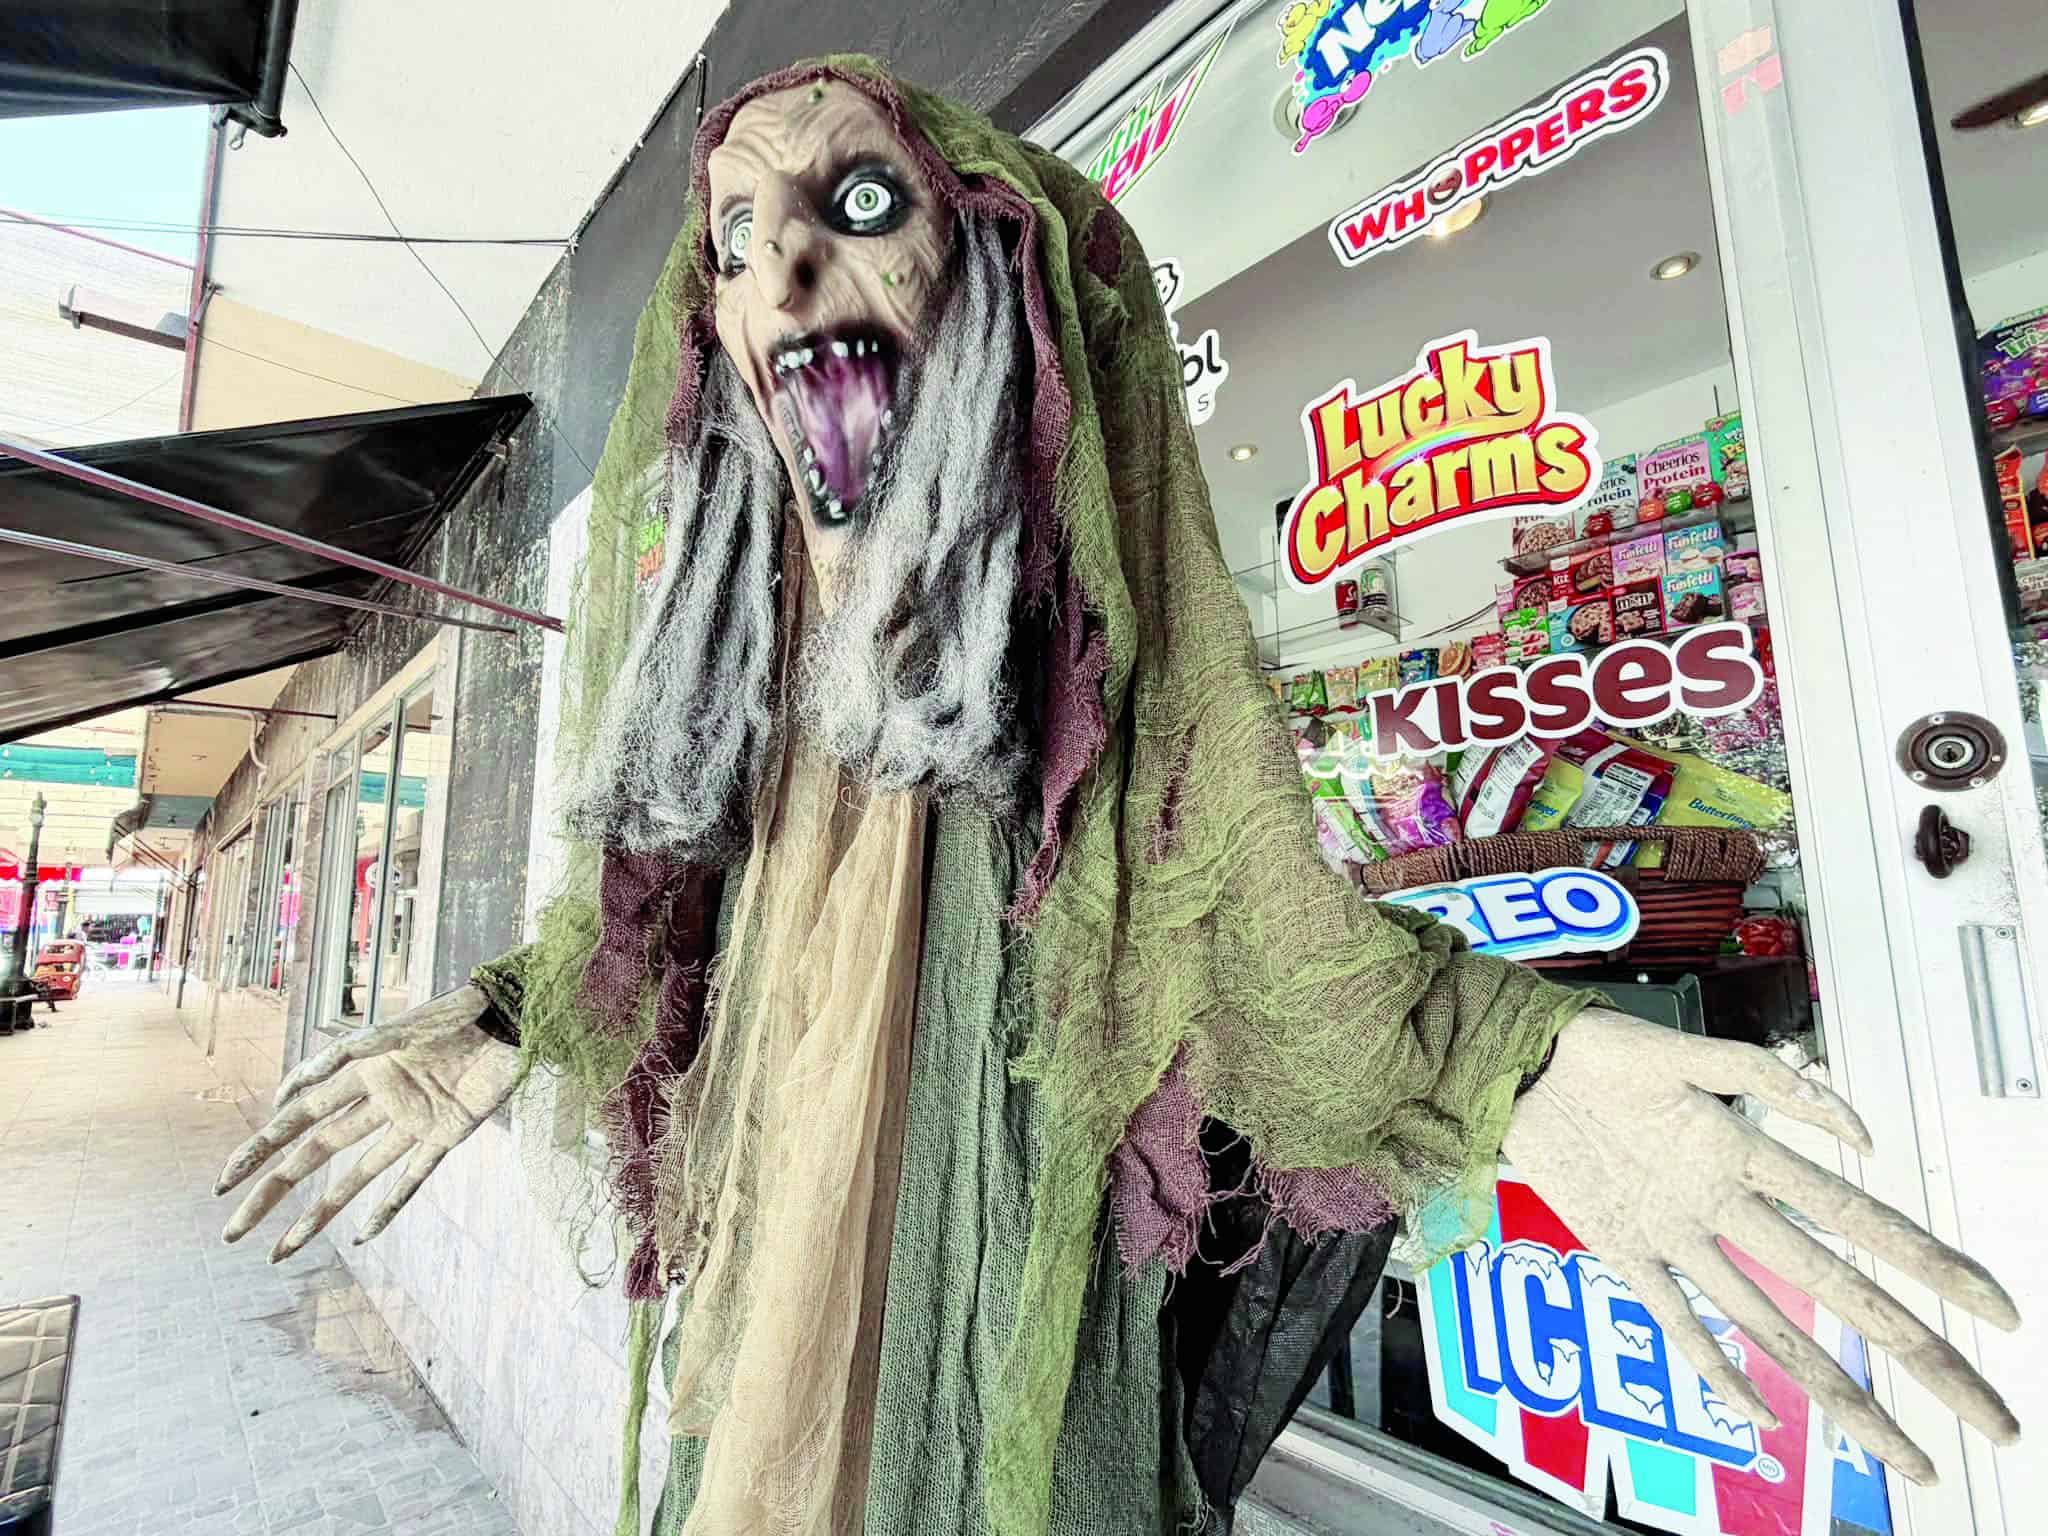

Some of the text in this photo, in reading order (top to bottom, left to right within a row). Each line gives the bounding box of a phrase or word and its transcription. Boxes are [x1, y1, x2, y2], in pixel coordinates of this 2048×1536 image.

[1316, 0, 1432, 78] Ne
[1345, 66, 1648, 250] WHOPPERS
[1311, 340, 1545, 482] Lucky
[1645, 452, 1700, 477] Cheerios
[1643, 465, 1706, 491] Protein
[1292, 423, 1590, 582] Charms
[1586, 487, 1632, 507] rotein
[1619, 541, 1658, 561] Funfetti
[1667, 527, 1719, 551] Funfetti
[1666, 570, 1713, 593] Funfetti
[1402, 874, 1622, 947] REO
